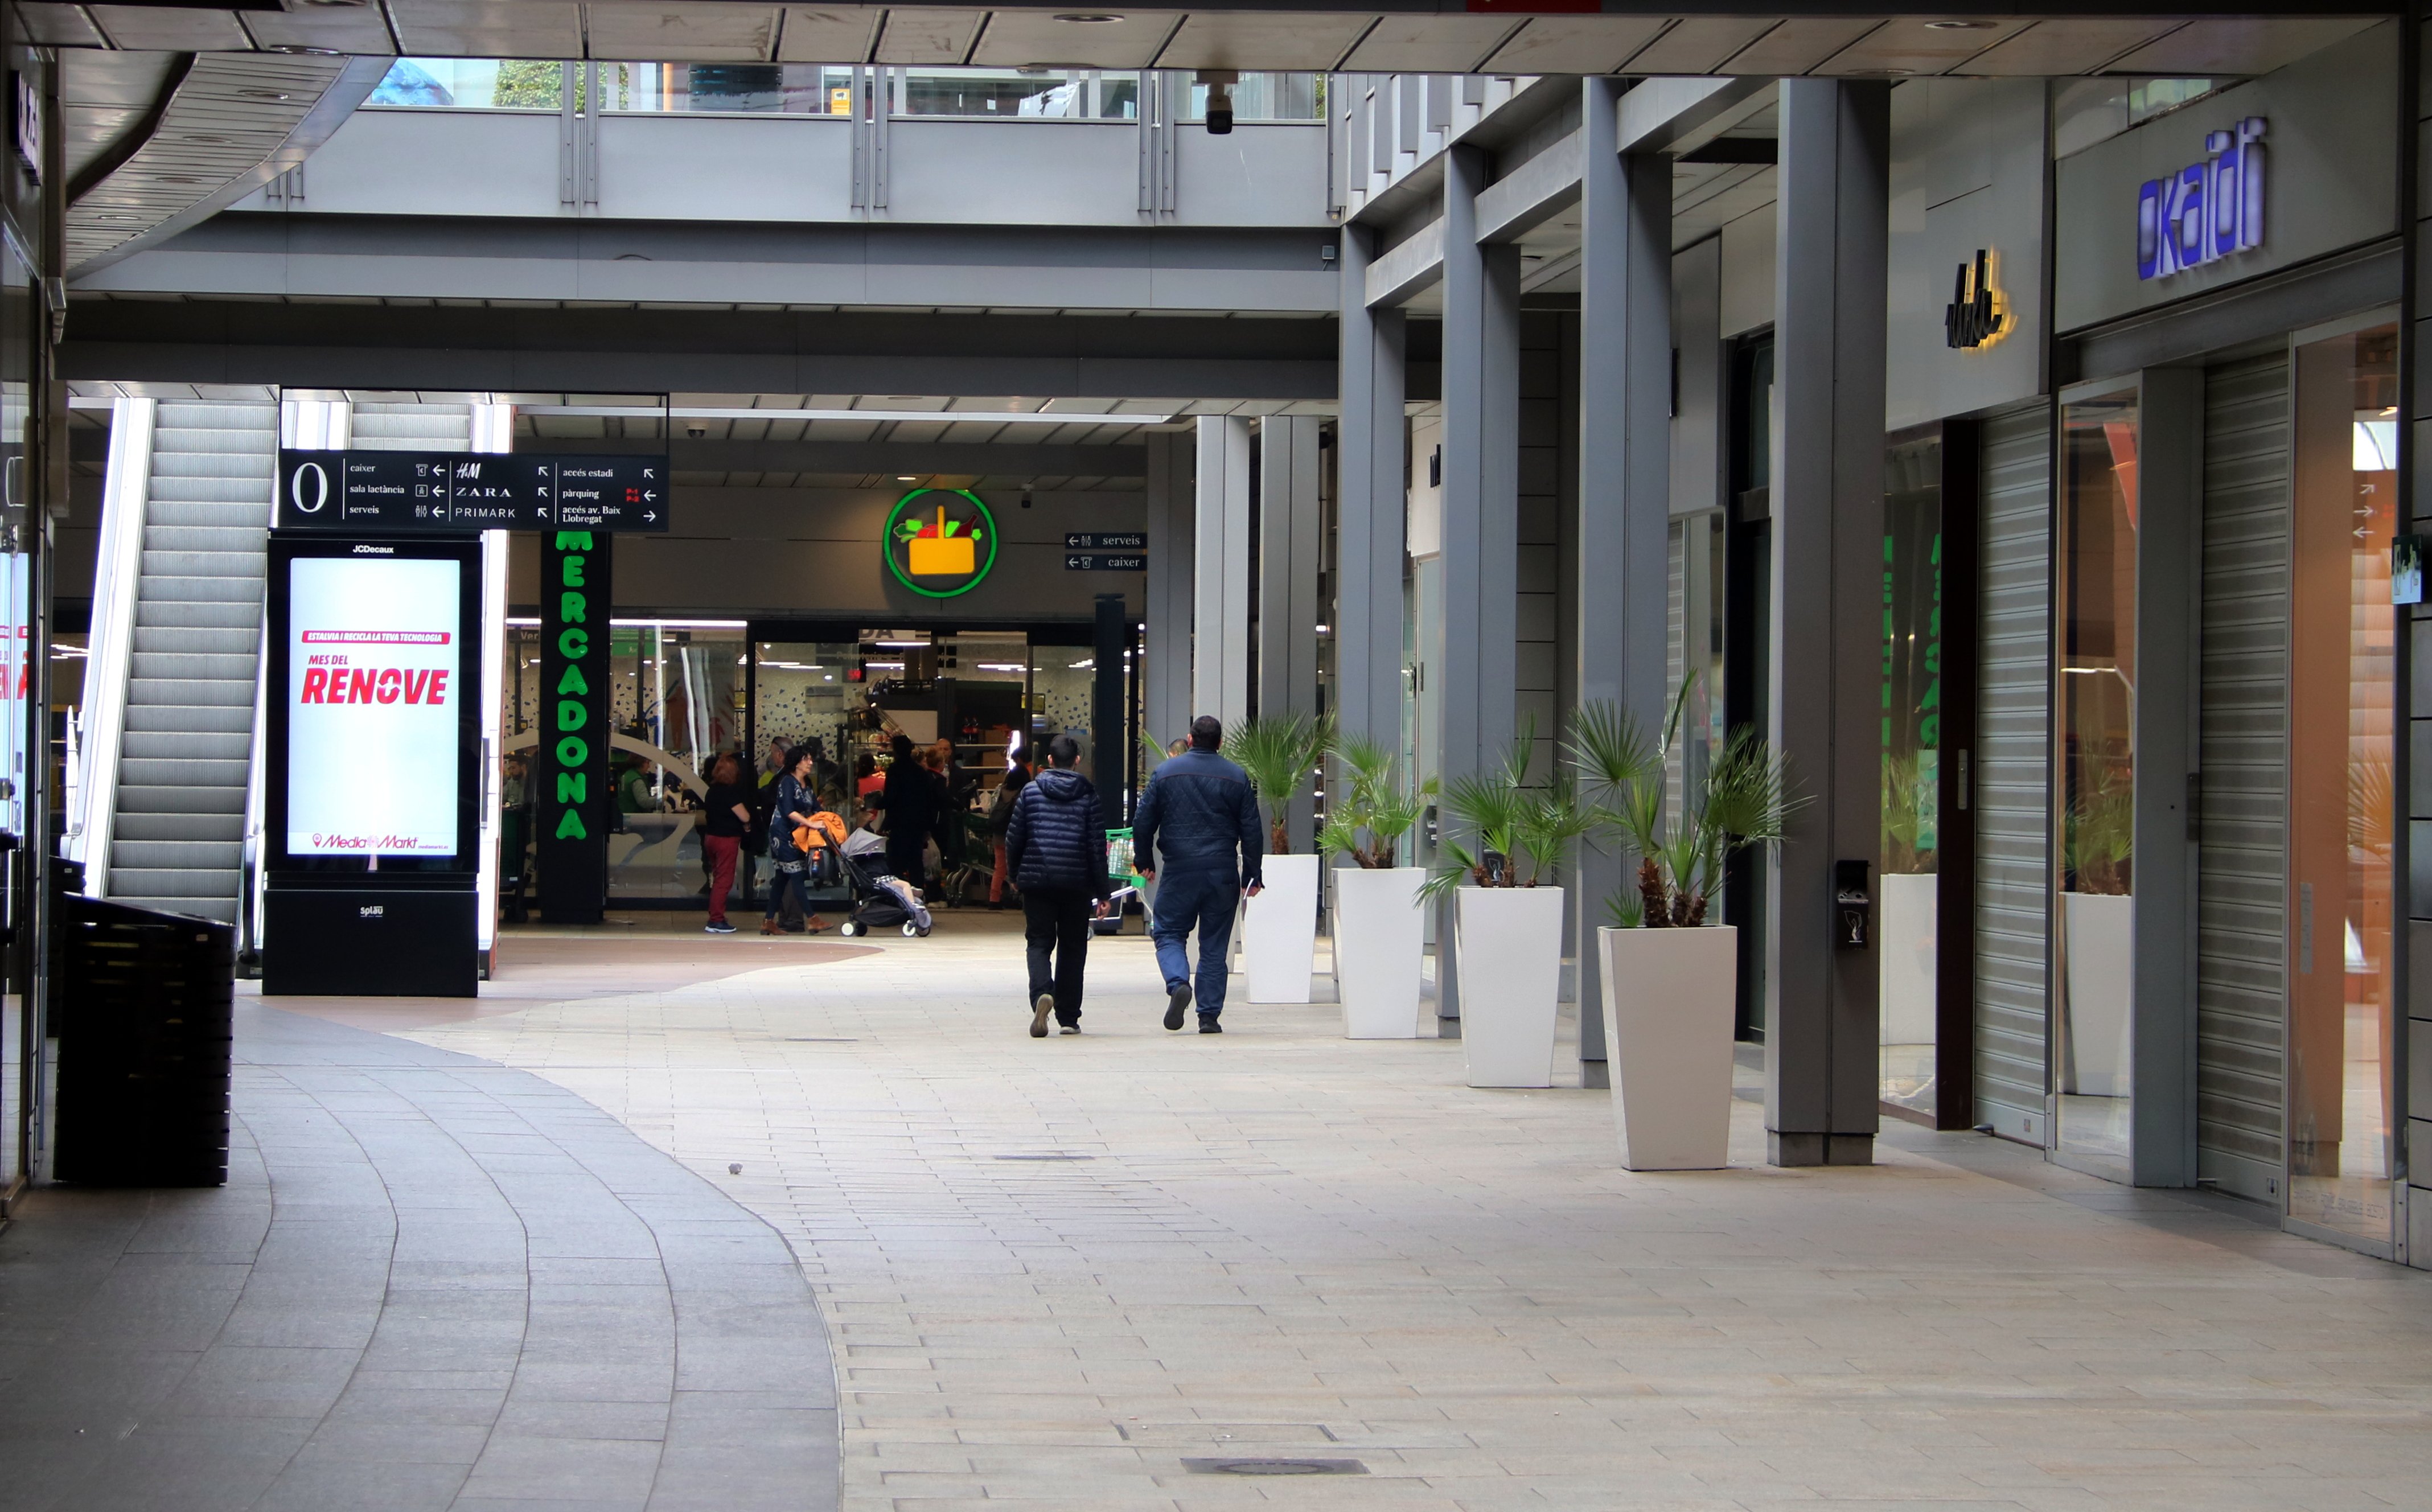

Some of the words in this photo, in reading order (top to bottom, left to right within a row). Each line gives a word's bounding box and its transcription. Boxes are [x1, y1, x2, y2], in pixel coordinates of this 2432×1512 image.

[456, 462, 481, 479] H&M
[563, 469, 586, 477] accés
[589, 466, 613, 477] estadi
[368, 484, 405, 494] lactància
[455, 487, 512, 497] ZARA
[562, 488, 599, 499] pàrquing
[349, 505, 380, 513] serveis
[455, 508, 515, 518] PRIMARK
[562, 505, 586, 513] accés
[602, 506, 621, 514] Baix
[562, 515, 602, 524] Llobregat
[1103, 535, 1140, 545] serveis
[1108, 557, 1140, 566] caixer
[400, 634, 442, 642] TECNOLOGIA
[308, 655, 329, 665] MES
[331, 656, 348, 665] DEL
[301, 668, 449, 705] RENOVE
[556, 531, 593, 840] MERCADONA
[322, 835, 367, 848] Media
[377, 835, 418, 849] Markt
